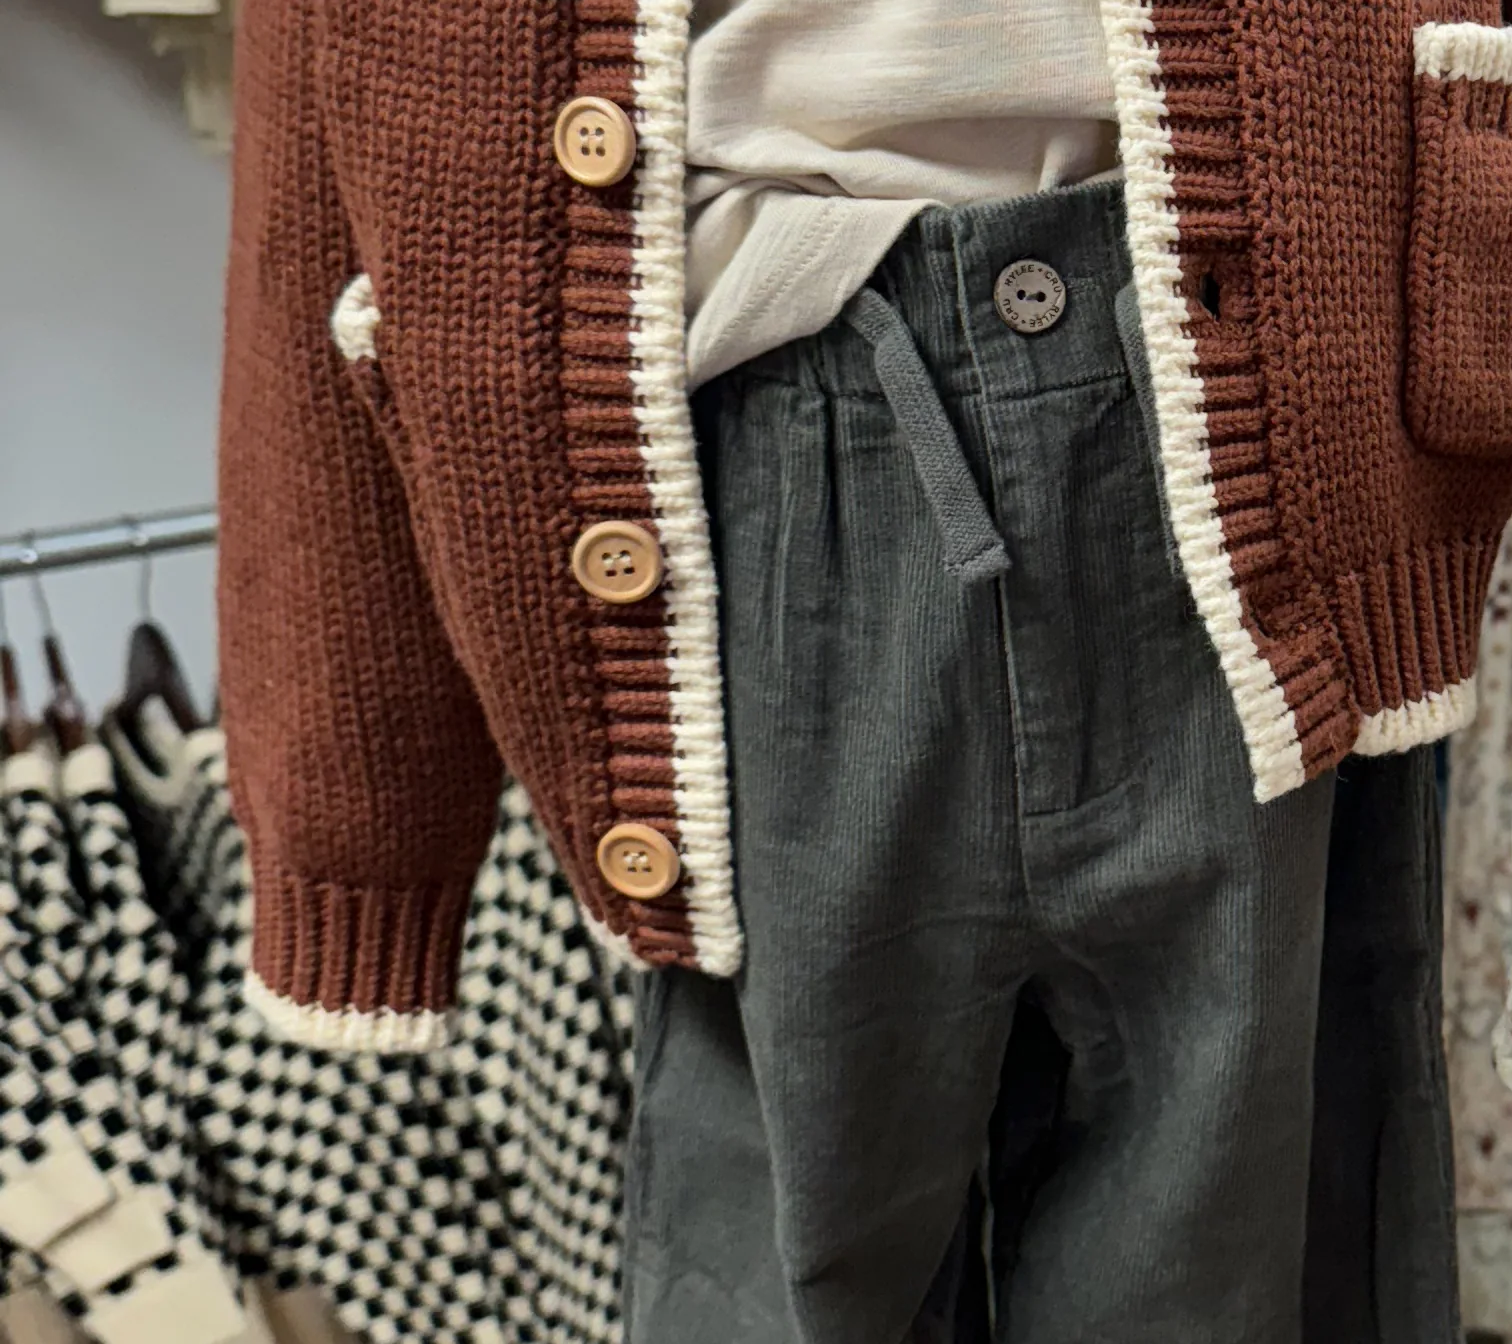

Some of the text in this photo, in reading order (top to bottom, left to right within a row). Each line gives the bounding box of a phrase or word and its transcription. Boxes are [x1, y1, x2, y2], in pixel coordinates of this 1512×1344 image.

[1004, 264, 1062, 293] RYLEE CRU
[1002, 298, 1060, 328] RYLEE CRU
